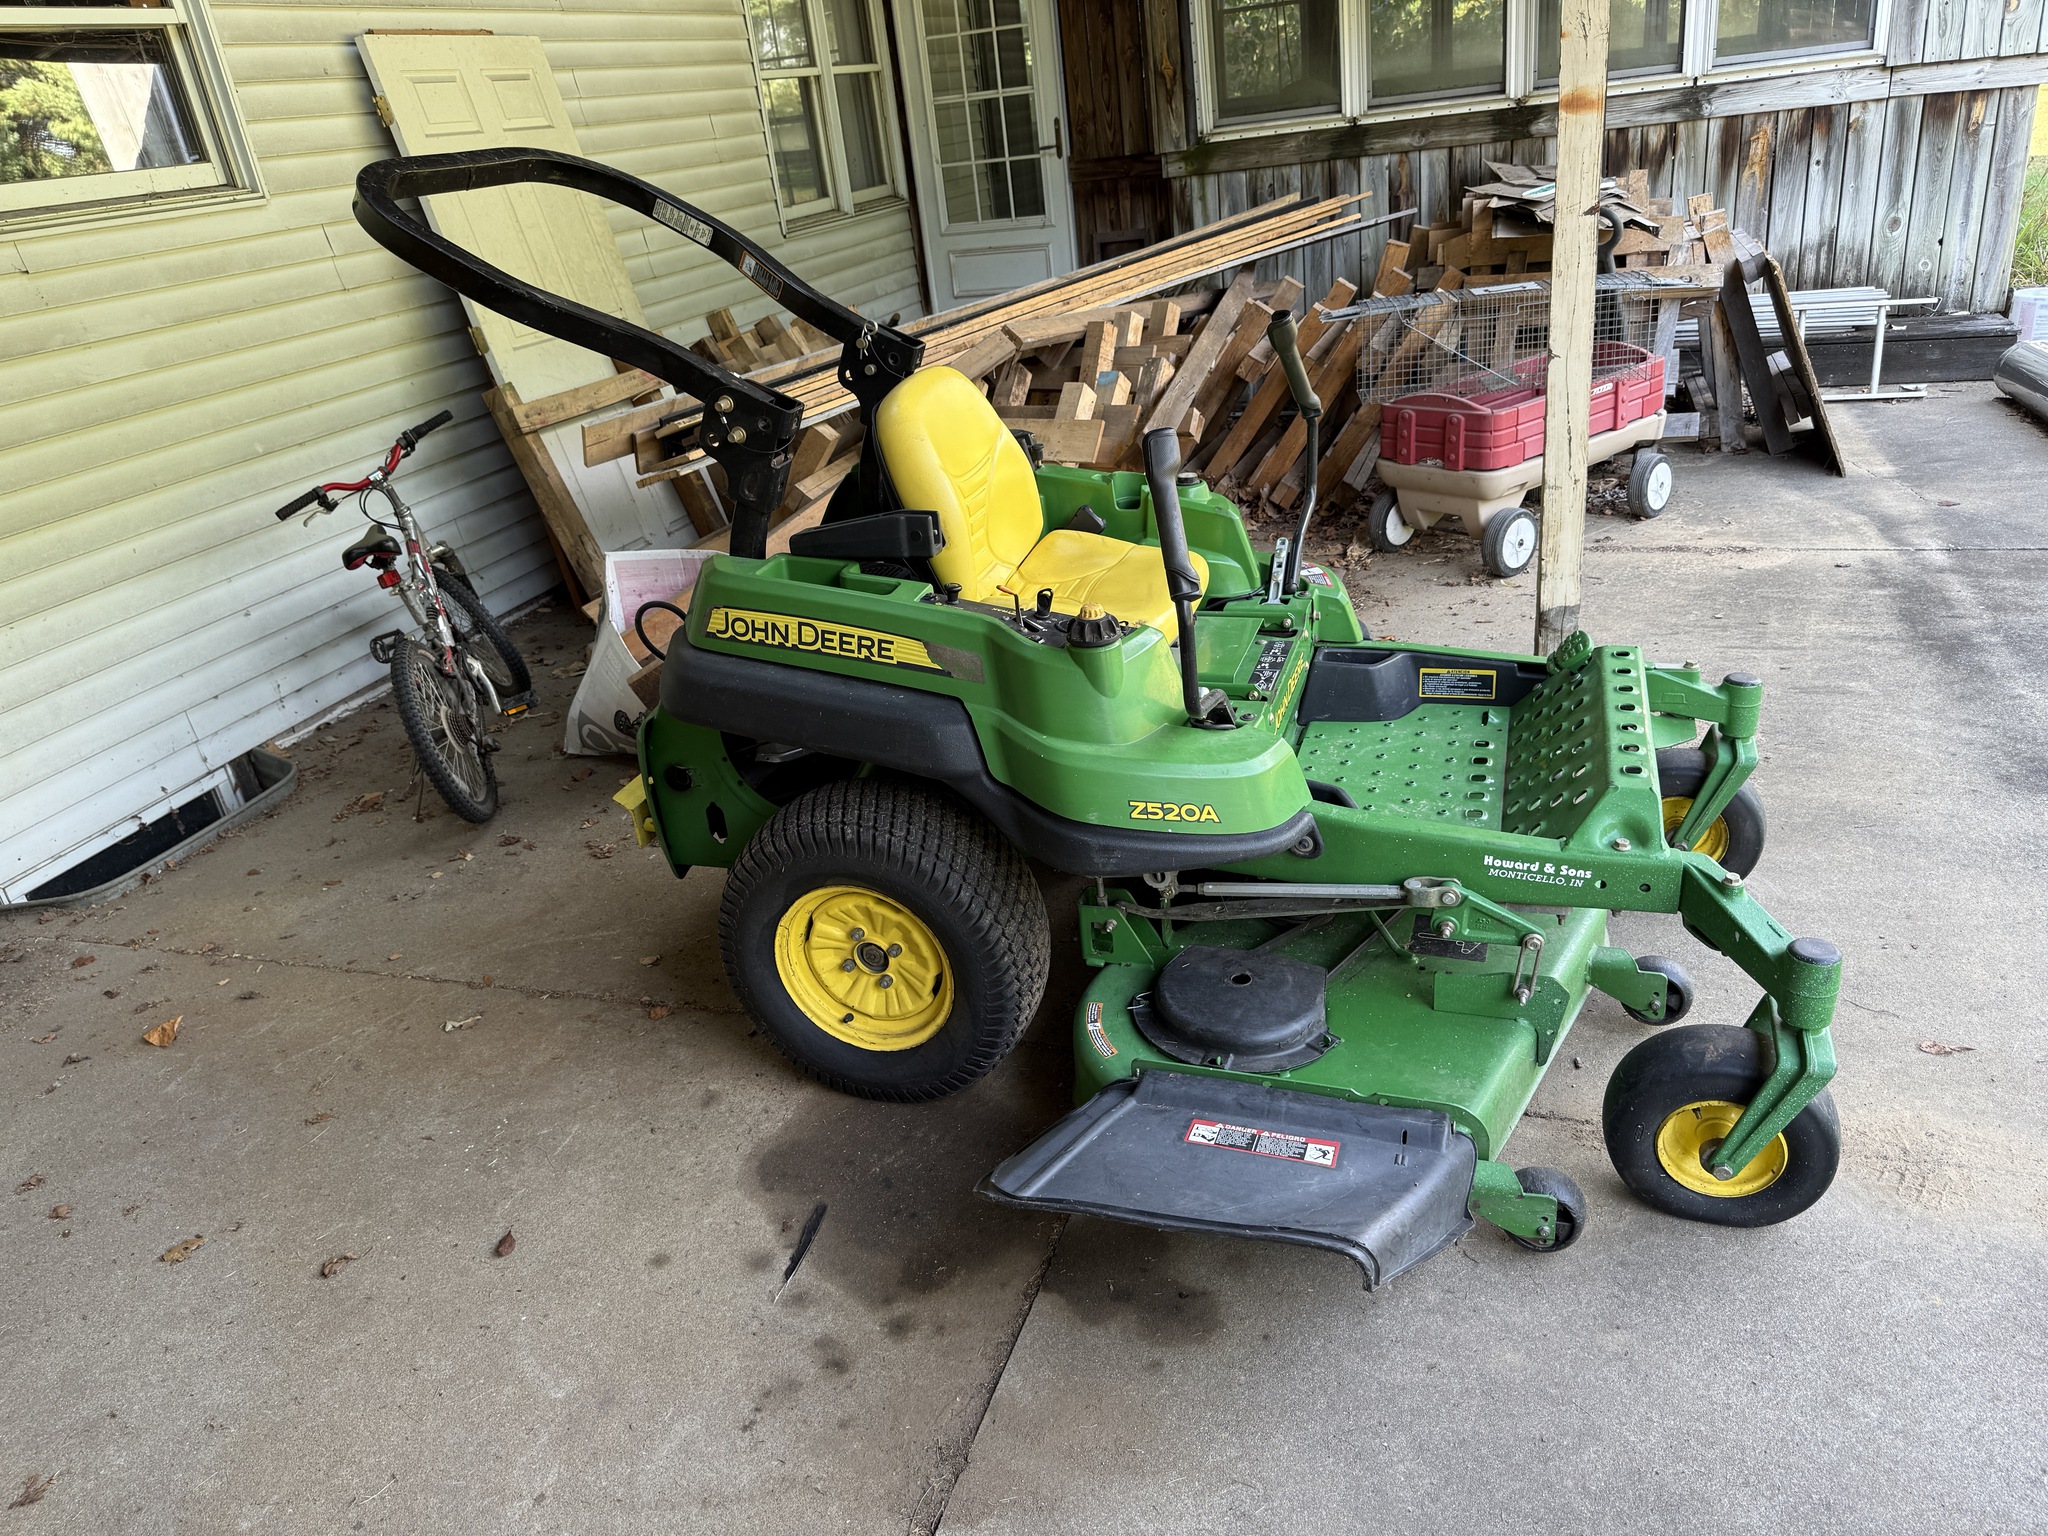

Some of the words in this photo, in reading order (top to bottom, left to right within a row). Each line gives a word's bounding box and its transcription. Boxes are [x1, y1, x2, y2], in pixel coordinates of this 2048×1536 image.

[716, 611, 790, 643] JOHN
[797, 621, 894, 661] DEERE
[1129, 800, 1221, 824] Z520A
[1484, 855, 1539, 872] Howard
[1543, 863, 1556, 874] &
[1560, 865, 1592, 879] Sons
[1488, 868, 1567, 887] MONTICELLO,
[1569, 879, 1584, 887] IN
[1225, 1125, 1258, 1134] DANGER
[1271, 1132, 1306, 1142] PELIGRO
